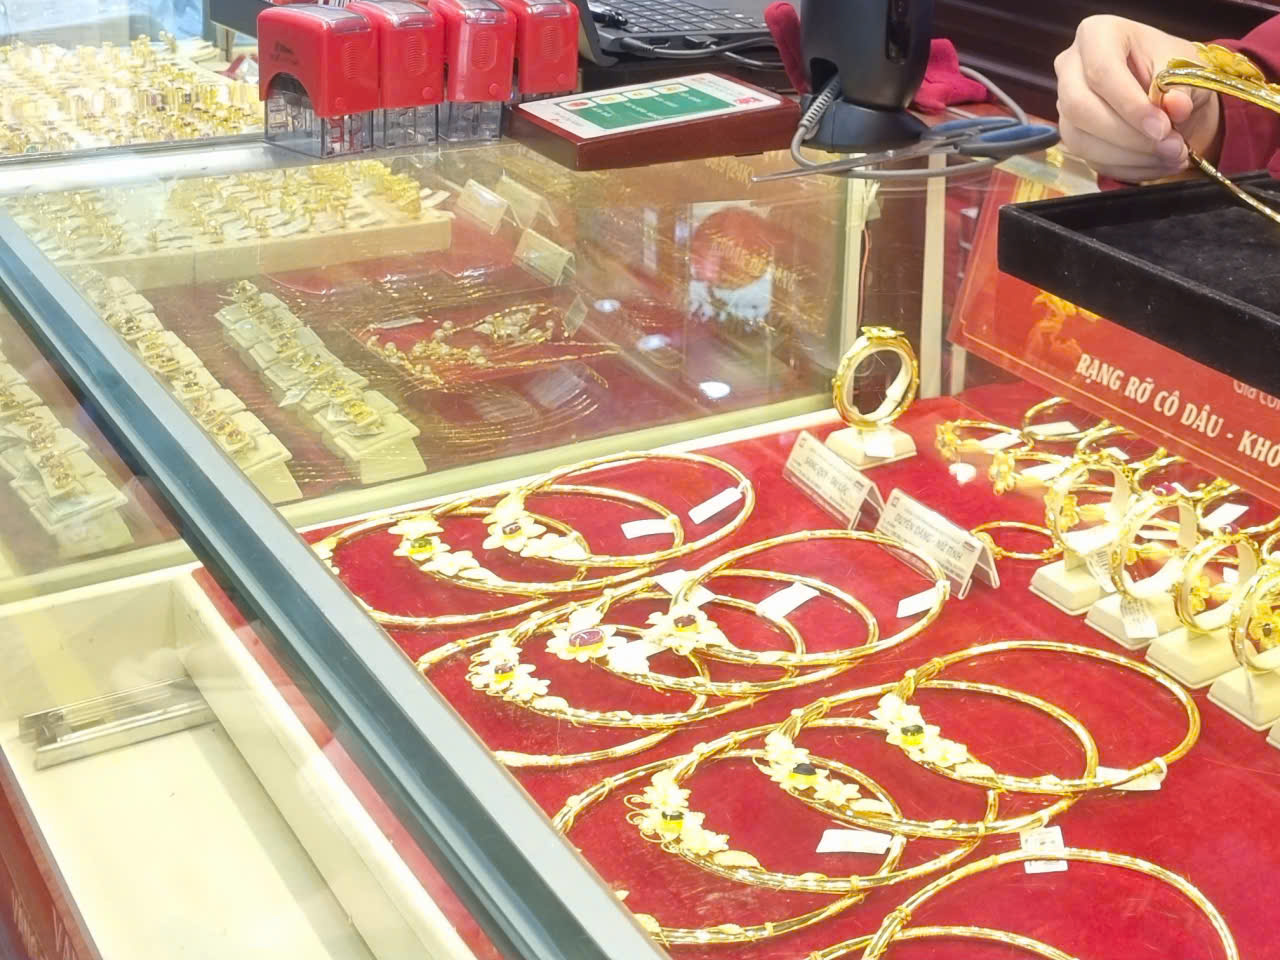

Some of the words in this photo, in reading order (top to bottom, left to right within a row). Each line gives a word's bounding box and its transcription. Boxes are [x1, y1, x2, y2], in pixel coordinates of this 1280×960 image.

[1075, 353, 1125, 392] RẠNG
[1152, 389, 1181, 418] CÔ
[1179, 402, 1226, 440] DÂU
